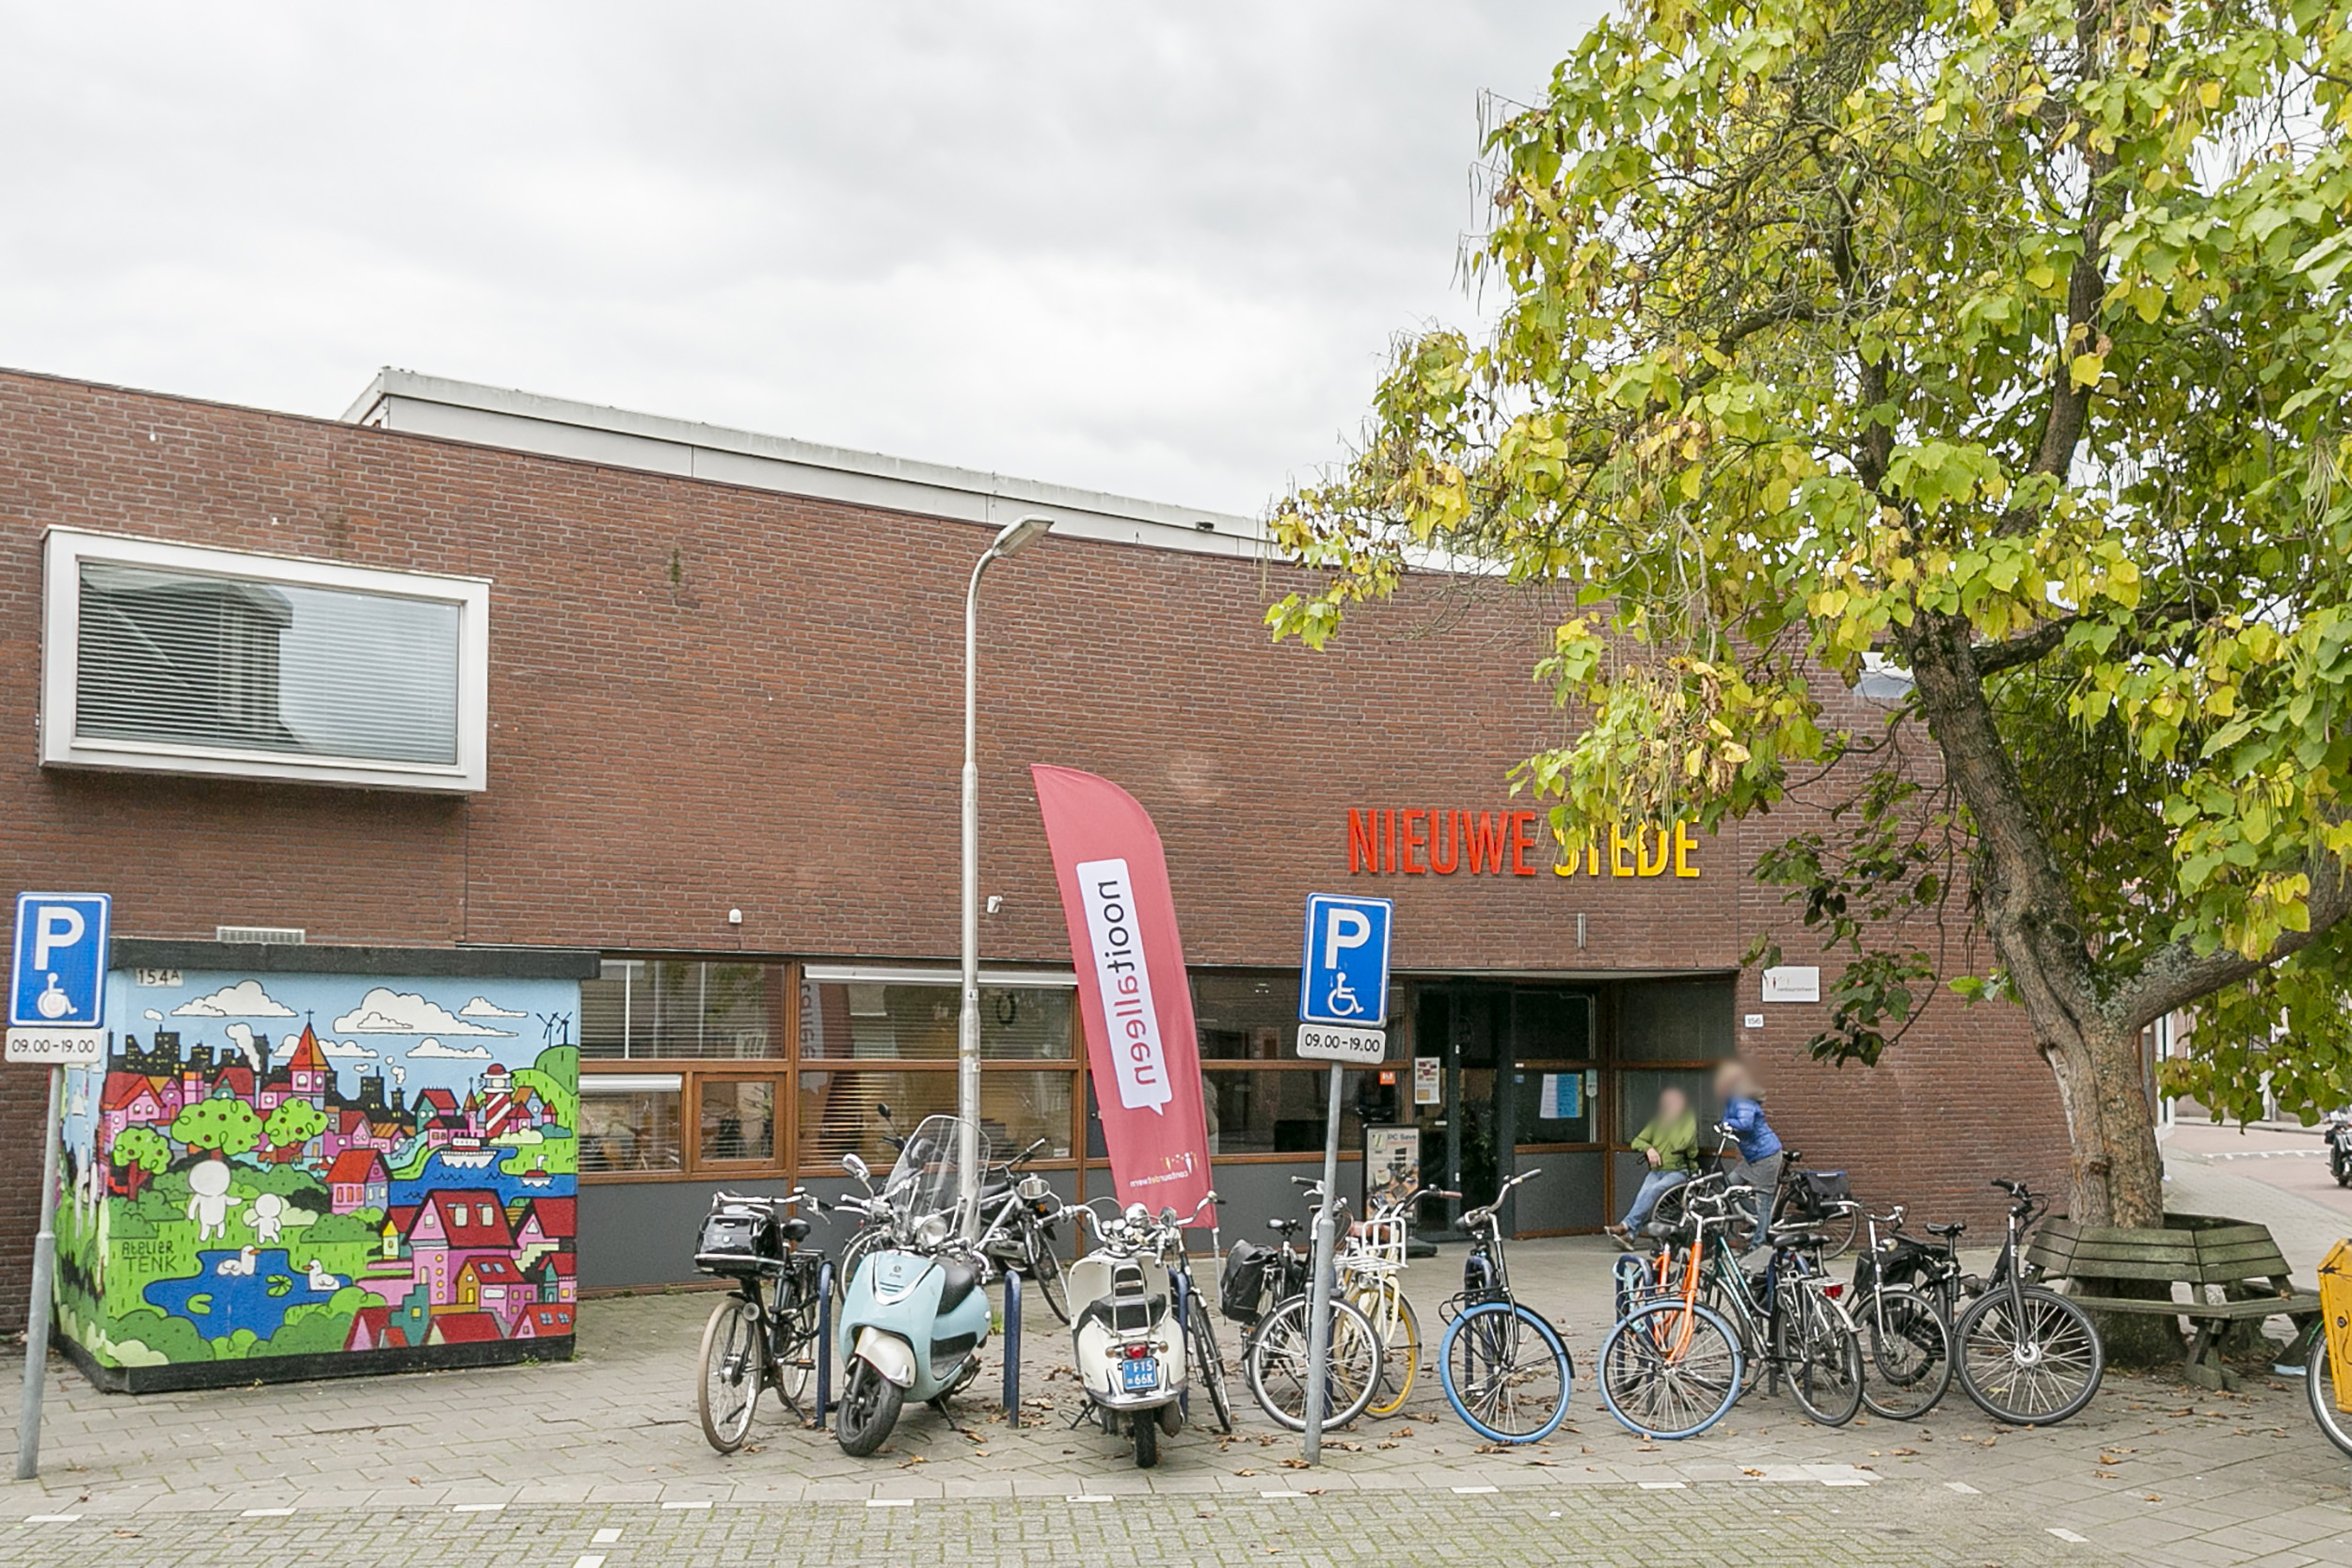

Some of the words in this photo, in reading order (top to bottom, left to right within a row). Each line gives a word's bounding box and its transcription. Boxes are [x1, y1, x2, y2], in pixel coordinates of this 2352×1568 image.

[1348, 808, 1536, 875] NIEUWE
[34, 906, 86, 971] P
[1325, 908, 1371, 970] P
[1747, 1017, 1762, 1025] 156
[123, 1256, 178, 1273] TENK
